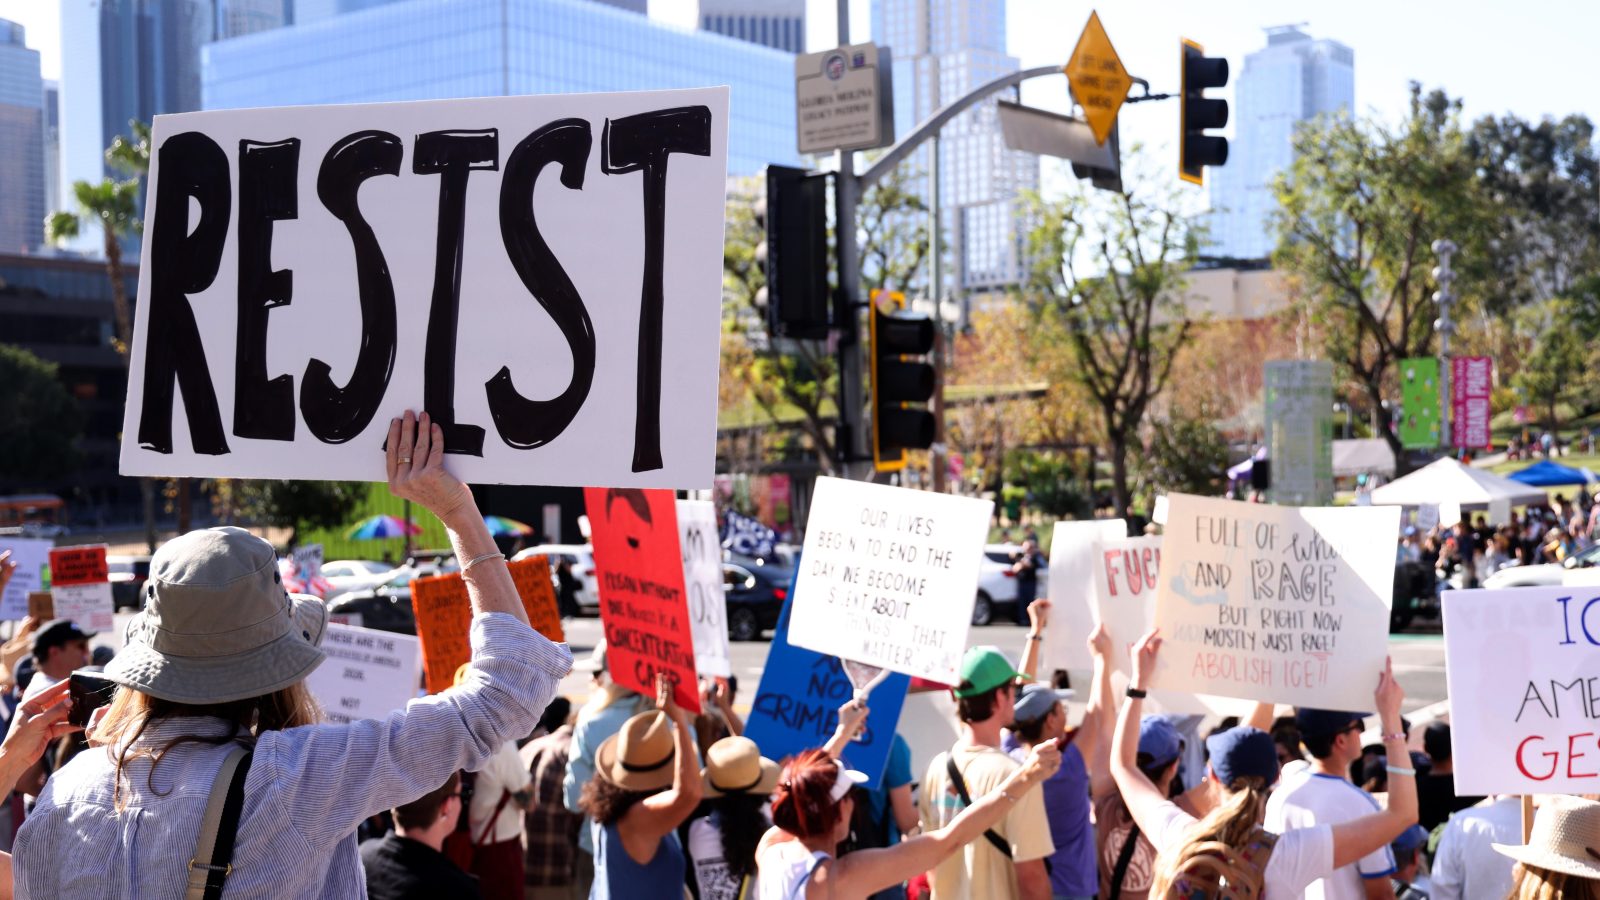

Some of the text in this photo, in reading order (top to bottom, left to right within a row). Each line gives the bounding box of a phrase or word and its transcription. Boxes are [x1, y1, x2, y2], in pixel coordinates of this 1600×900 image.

[138, 105, 711, 472] RESIST
[1466, 359, 1487, 446] GRAND PARK
[860, 507, 888, 528] OUR
[1196, 516, 1240, 547] FULL
[1255, 522, 1279, 550] OF
[817, 530, 953, 569] BEGN TO END THE
[640, 580, 680, 603] WITHOUT
[812, 559, 926, 597] DAY WE BECOME
[1195, 559, 1337, 607] AND RAGE
[871, 595, 911, 620] ABOUT
[1219, 606, 1342, 632] BUT RIGHT NOW
[326, 632, 394, 651] THESE ARE THE
[606, 623, 695, 673] CONCENTRATION
[912, 625, 948, 649] THAT
[1203, 628, 1256, 650] MOSTLY
[1262, 632, 1294, 653] JUST
[807, 673, 848, 699] NO
[1191, 652, 1273, 688] ABOLISH
[1516, 732, 1600, 781] GE
